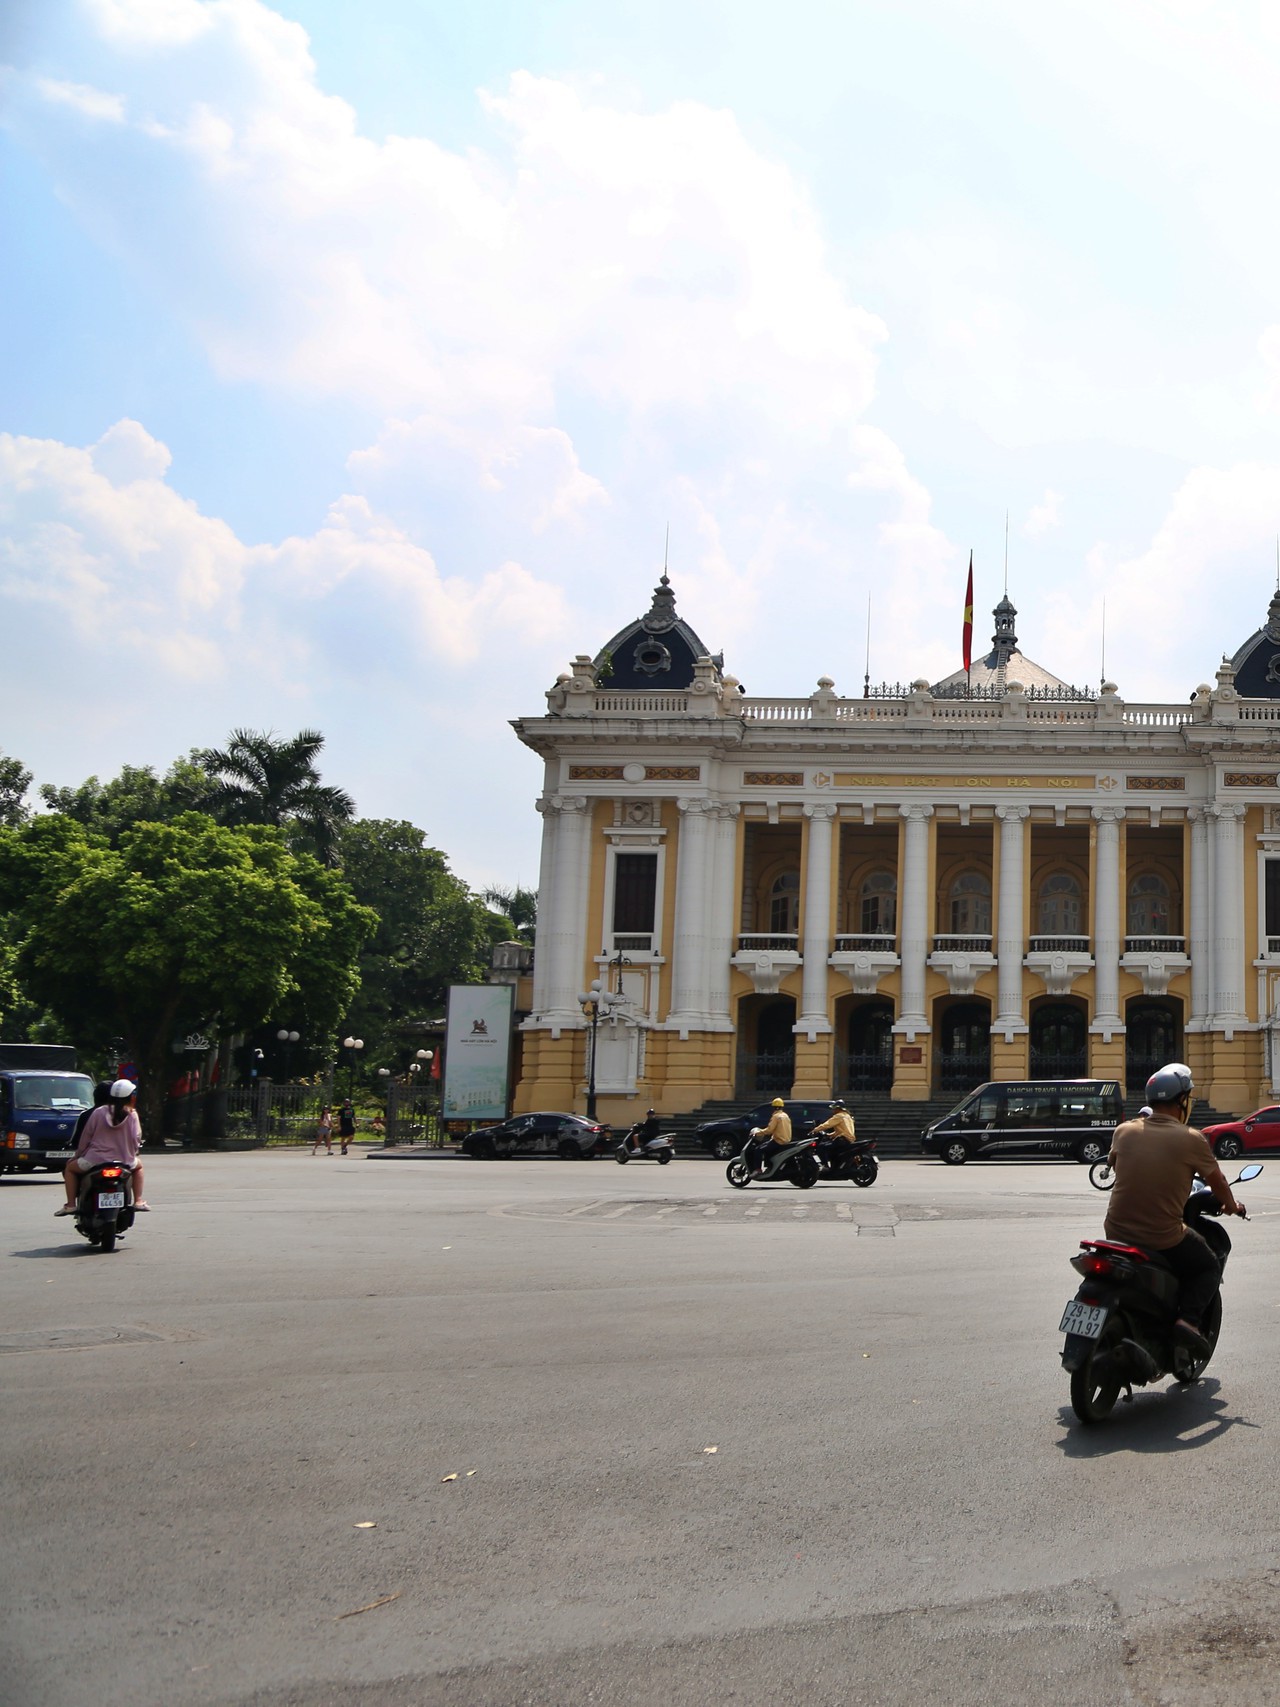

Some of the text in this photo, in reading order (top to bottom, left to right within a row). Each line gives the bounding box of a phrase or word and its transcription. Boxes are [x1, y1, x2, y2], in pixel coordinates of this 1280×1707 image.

[954, 776, 991, 787] LỚN
[1007, 776, 1032, 788] HÀ
[1047, 777, 1080, 789] NỘI
[1070, 1304, 1101, 1321] 29-Y3
[1062, 1317, 1100, 1337] 711.97
